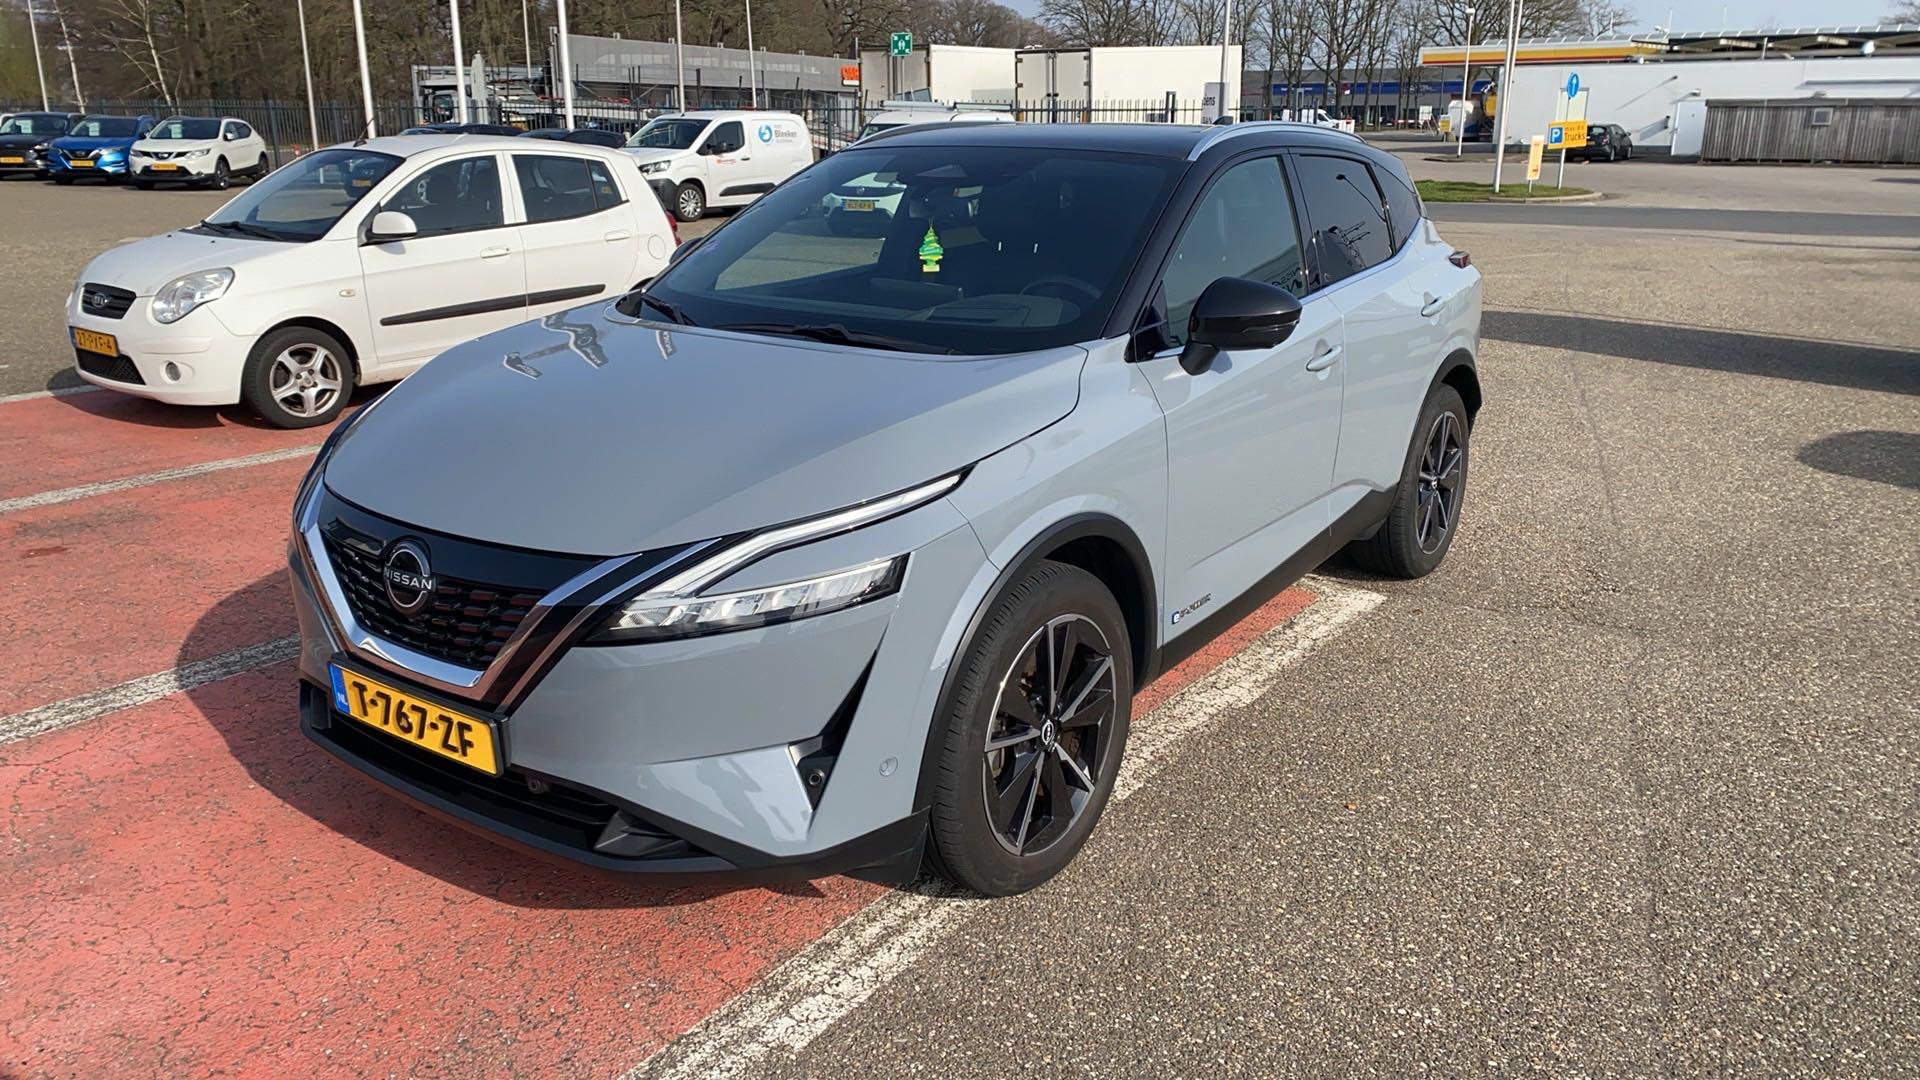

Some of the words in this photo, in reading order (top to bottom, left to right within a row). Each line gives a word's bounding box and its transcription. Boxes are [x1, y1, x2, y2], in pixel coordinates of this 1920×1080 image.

[1564, 132, 1586, 142] Trucks
[384, 567, 432, 590] NISSAN
[352, 680, 474, 757] T-767-ZF
